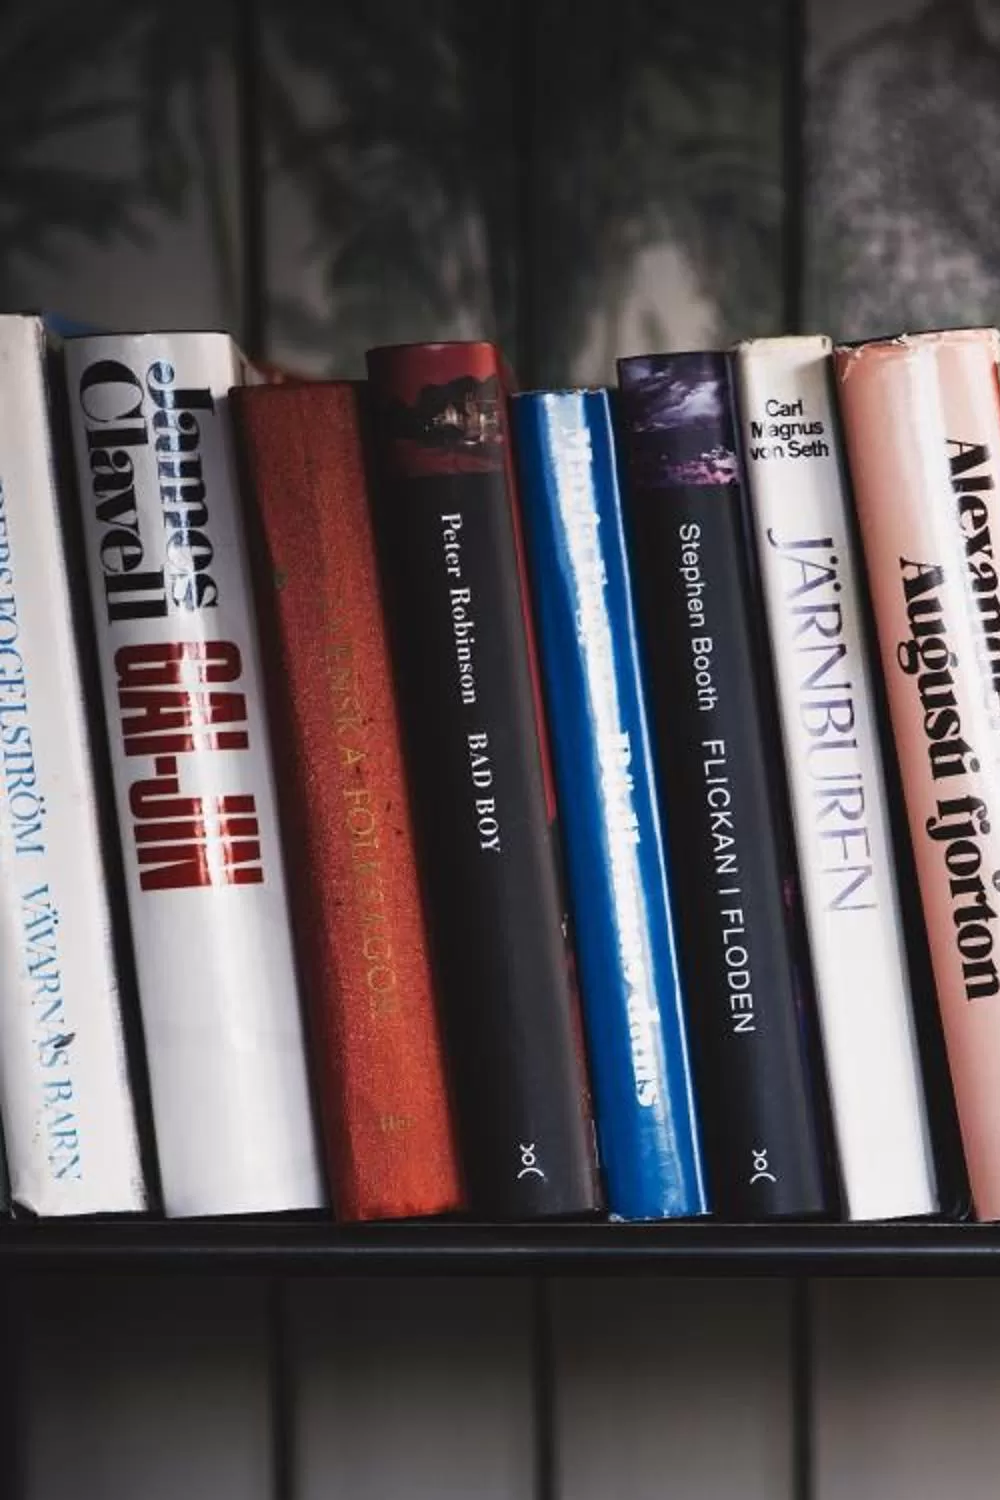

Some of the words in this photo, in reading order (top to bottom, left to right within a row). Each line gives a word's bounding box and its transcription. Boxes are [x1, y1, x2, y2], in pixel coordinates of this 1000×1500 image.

[750, 421, 824, 441] Magnus
[750, 445, 784, 460] von
[787, 440, 829, 458] Seth
[766, 399, 803, 417] Carl
[82, 360, 169, 625] Clavell
[146, 359, 219, 616] James
[441, 513, 463, 578] Peter
[679, 523, 706, 628] Stephen
[449, 587, 477, 705] Robinson
[691, 636, 718, 711] Booth
[890, 556, 981, 781] Augusti
[109, 636, 267, 894] GAI-JIN
[467, 732, 493, 788] BAD
[768, 527, 878, 911] JÄRNBUREN
[475, 797, 501, 852] BOY
[701, 739, 738, 874] FLICKAN
[718, 887, 741, 895] I
[926, 794, 1000, 1002] fjorton
[22, 883, 74, 1067] VÄVARNAS
[720, 908, 756, 1033] FLODEN
[45, 1078, 81, 1179] BARN
